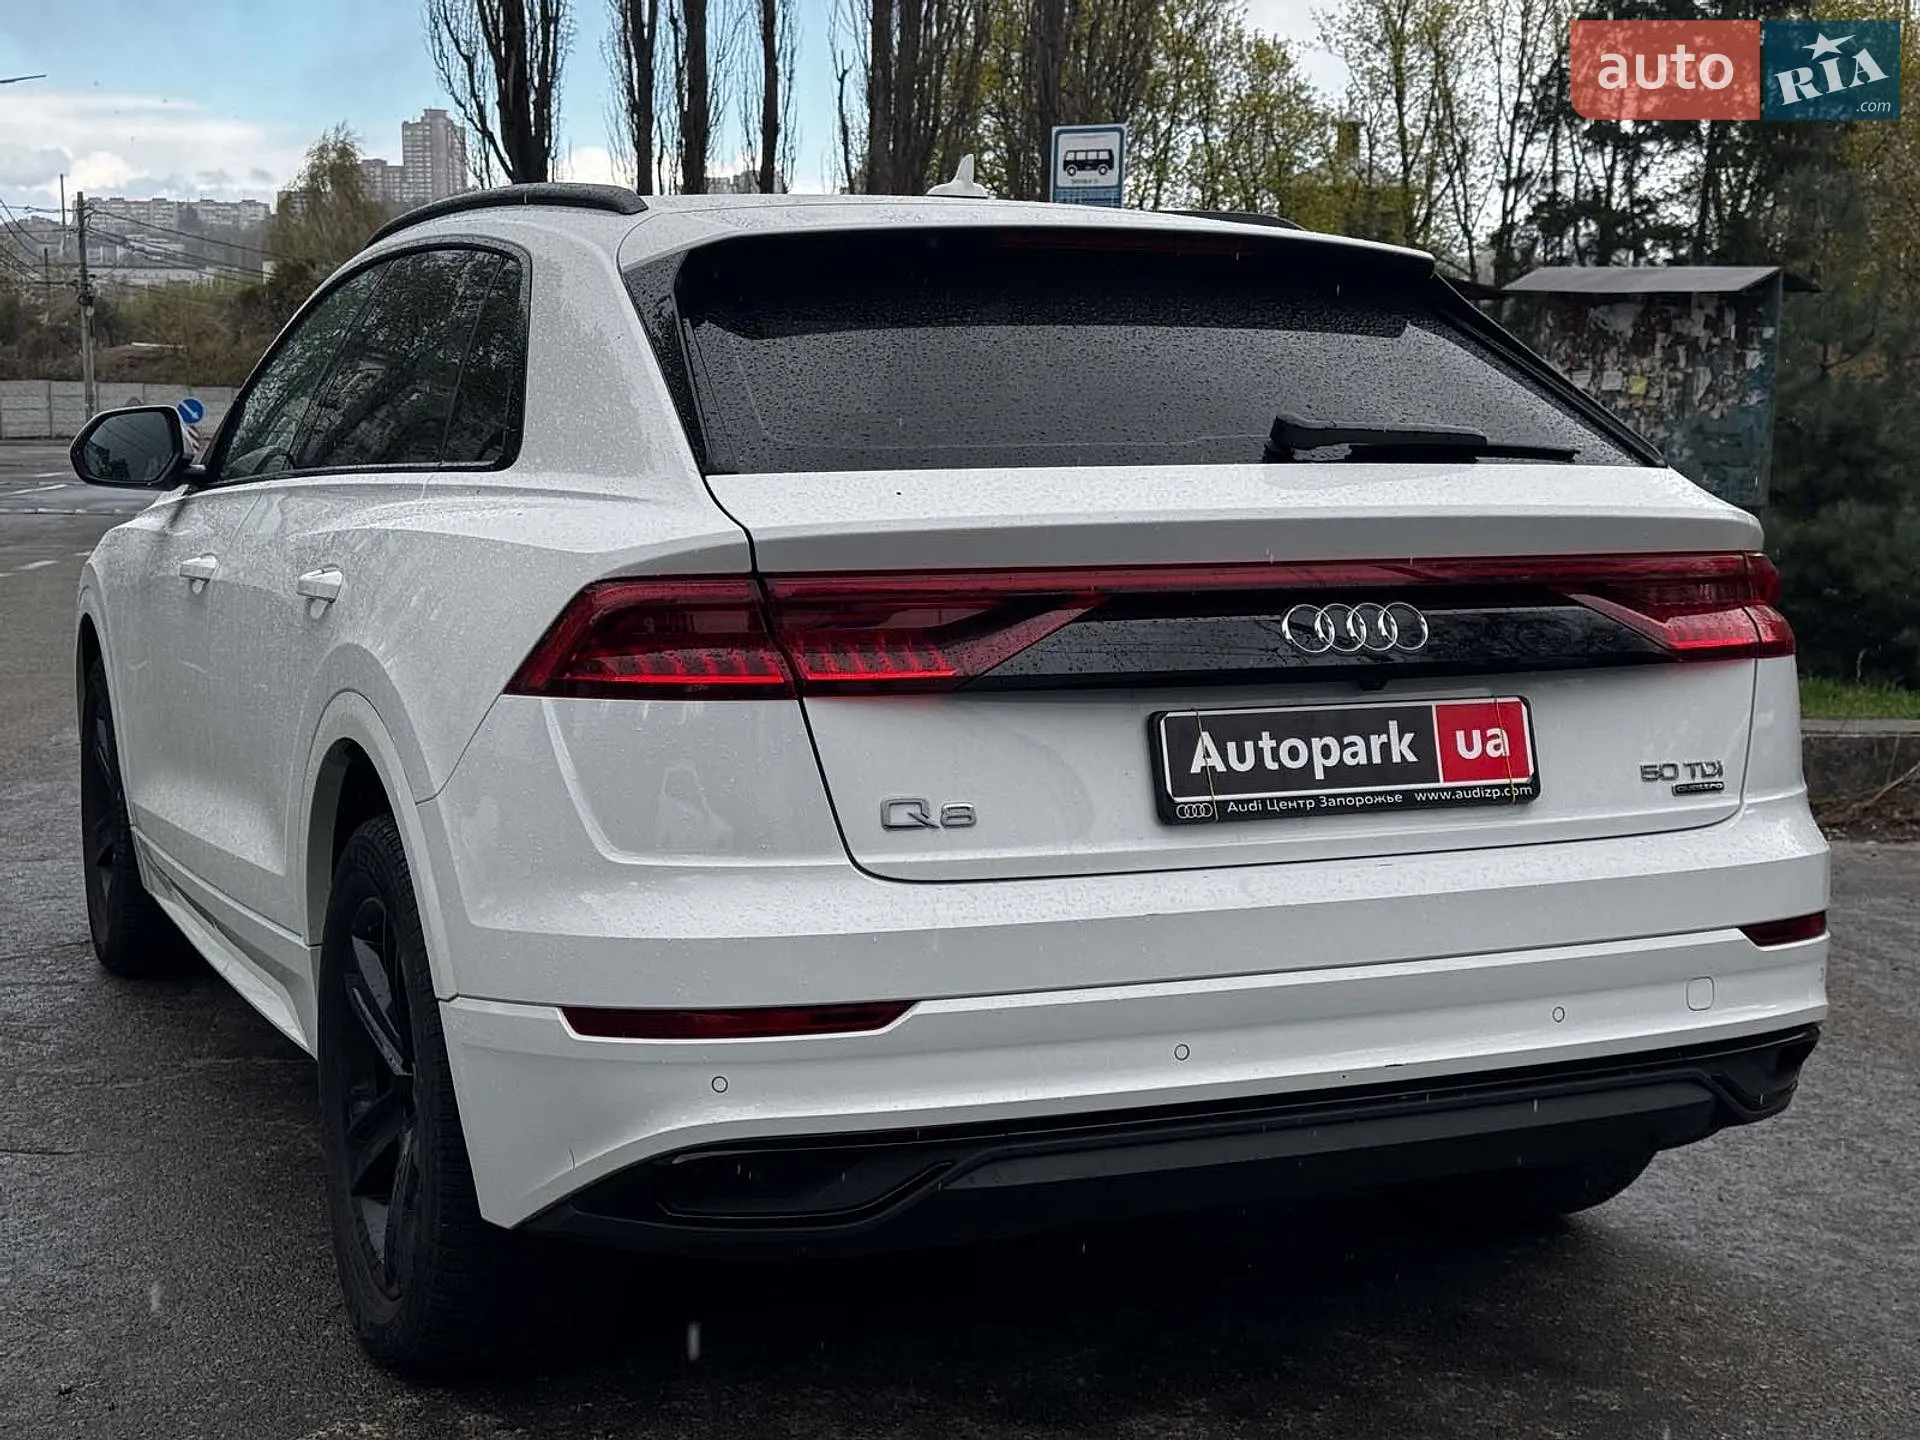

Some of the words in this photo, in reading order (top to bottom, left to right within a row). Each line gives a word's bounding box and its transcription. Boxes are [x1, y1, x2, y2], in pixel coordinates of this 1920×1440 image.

[1189, 720, 1419, 781] Autopark
[1455, 727, 1510, 760] ua
[881, 799, 977, 830] Q8
[1227, 801, 1262, 813] Audi
[1266, 799, 1315, 812] Центр
[1319, 792, 1403, 808] Запорожье
[1414, 786, 1533, 801] www.audizp.com
